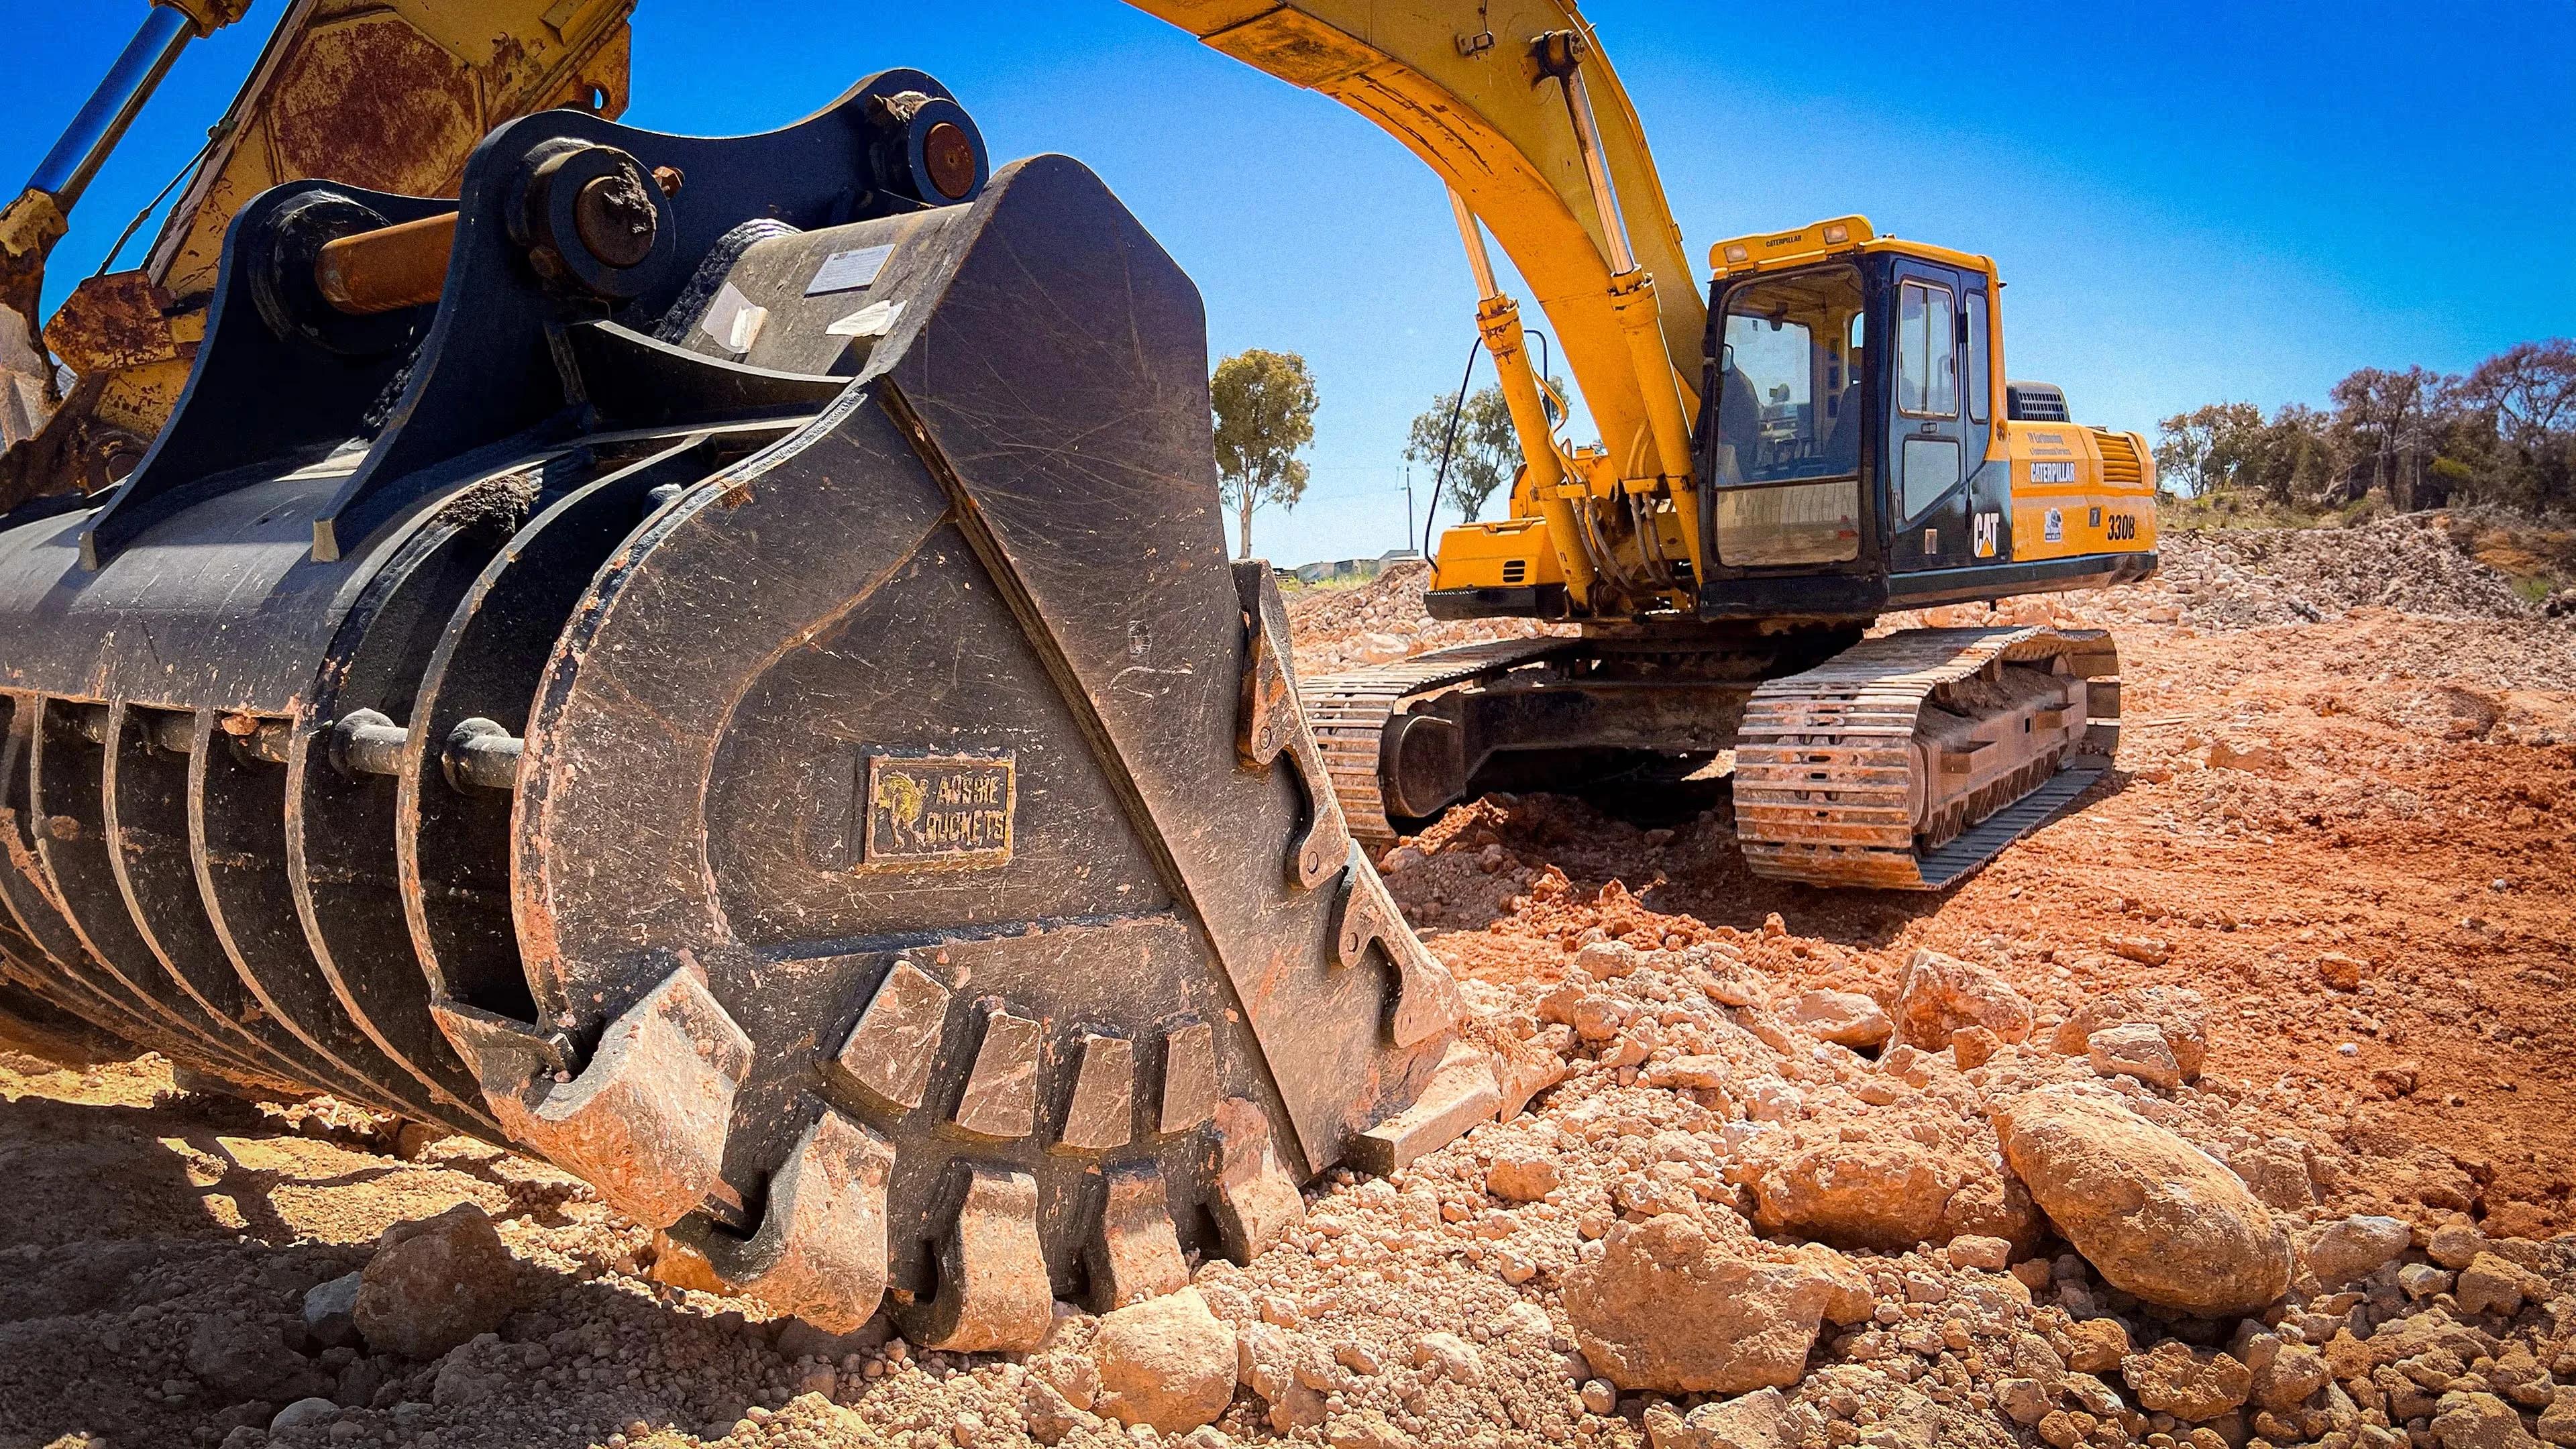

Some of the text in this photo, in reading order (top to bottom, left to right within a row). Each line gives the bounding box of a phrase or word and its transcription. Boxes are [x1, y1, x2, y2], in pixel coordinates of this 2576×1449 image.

[1766, 235, 1802, 248] CATERPILLAR
[2031, 462, 2075, 483] CATERPILLAR
[1974, 513, 1999, 558] CAT
[2108, 515, 2135, 541] 330B
[935, 774, 1001, 804] AUSSIE
[924, 809, 1006, 843] BUCKETS
